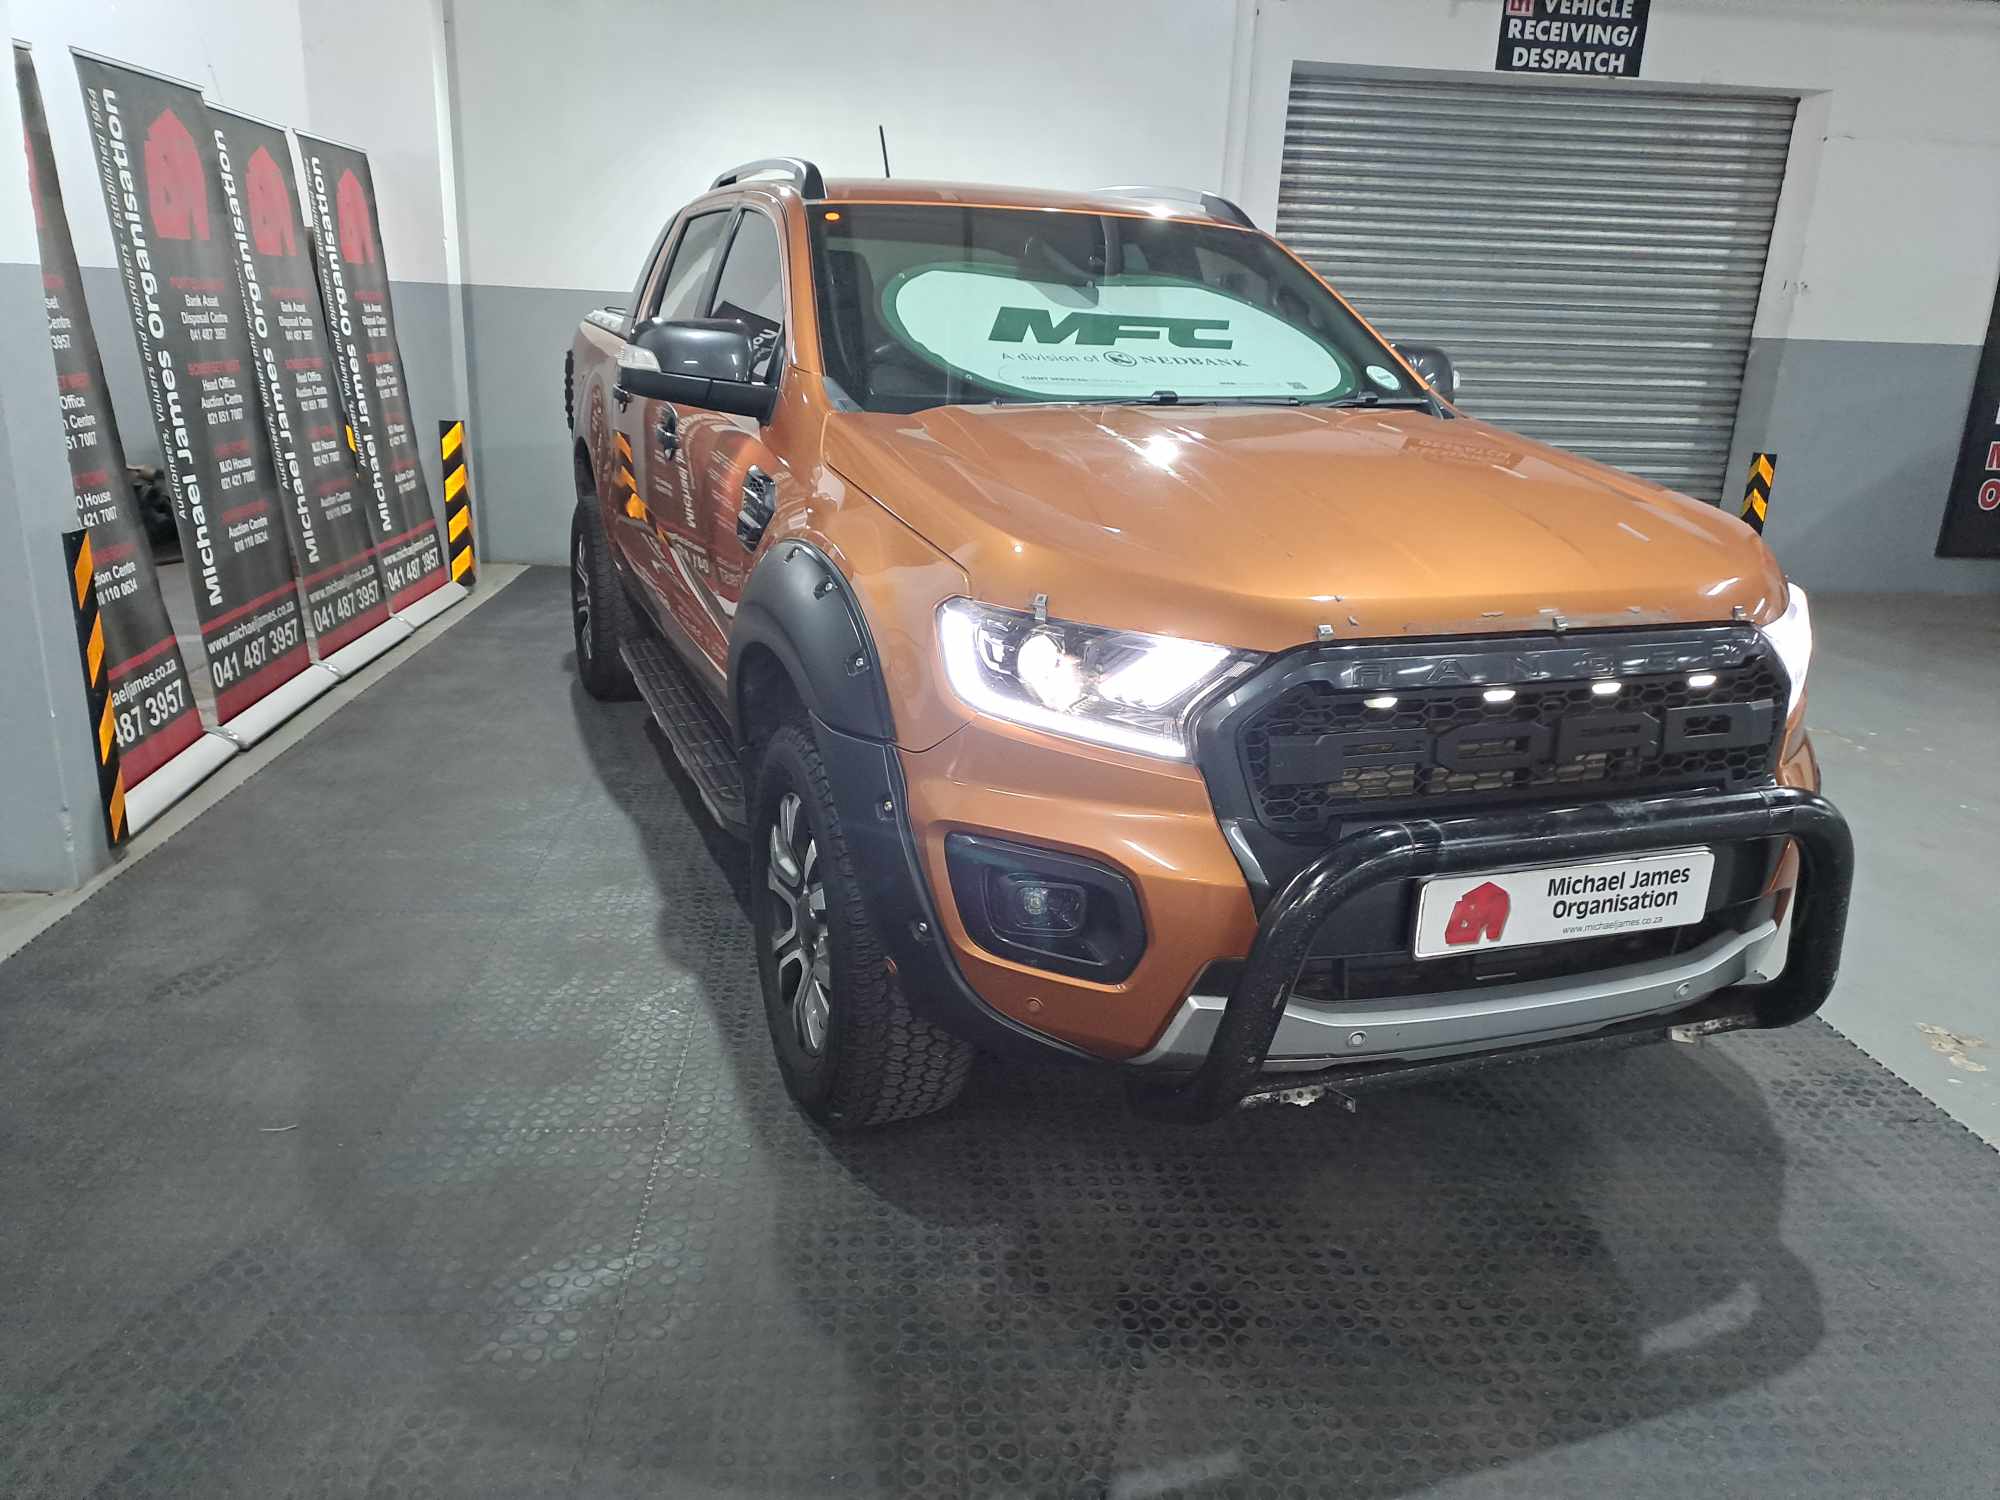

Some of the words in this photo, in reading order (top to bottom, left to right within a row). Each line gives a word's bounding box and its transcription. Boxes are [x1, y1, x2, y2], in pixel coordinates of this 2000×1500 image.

[1545, 0, 1633, 19] VEHICLE
[1507, 18, 1638, 47] RECEIVING/
[1511, 46, 1626, 74] DESPATCH
[96, 132, 124, 230] Established
[102, 88, 165, 340] Organisation
[214, 129, 268, 339] Organisation
[311, 157, 352, 337] Organisation
[121, 243, 146, 328] Appraisers
[322, 268, 339, 329] Appraisers
[51, 335, 71, 349] 3957
[137, 331, 153, 362] and
[248, 331, 260, 359] and
[333, 331, 342, 353] and
[988, 305, 1233, 350] MFC
[338, 356, 351, 397] Valuers
[1001, 351, 1012, 361] A
[1017, 352, 1082, 363] division
[1086, 353, 1099, 364] of
[1139, 355, 1249, 368] NEDBANK
[60, 394, 86, 409] Office
[148, 366, 166, 423] Valuers
[254, 360, 269, 409] Valuers
[263, 347, 293, 443] James
[346, 343, 371, 427] James
[70, 414, 96, 428] Centre
[157, 350, 193, 465] James
[66, 436, 79, 450] 51
[79, 431, 97, 447] 7007
[84, 490, 111, 507] House
[362, 434, 392, 532] Michael
[83, 512, 99, 528] 421
[99, 506, 117, 523] 7007
[284, 451, 320, 564] Michael
[181, 473, 223, 606] Michael
[106, 586, 120, 602] 110
[120, 577, 138, 596] 0634
[112, 561, 136, 579] Centre
[387, 568, 406, 592] 041
[406, 557, 420, 581] 487
[207, 600, 295, 655] www.michaeljames.co.za
[313, 602, 336, 633] 041
[337, 590, 356, 620] 487
[356, 579, 380, 610] 3957
[212, 651, 241, 689] 041
[243, 635, 267, 670] 487
[268, 617, 300, 656] 3957
[112, 658, 177, 706] aeljames.co.za
[145, 678, 185, 727] 3957
[1547, 872, 1624, 897] Michael
[1630, 867, 1690, 889] James
[1552, 889, 1679, 920] Organisation
[1562, 915, 1663, 935] www.michaeljames.co.za
